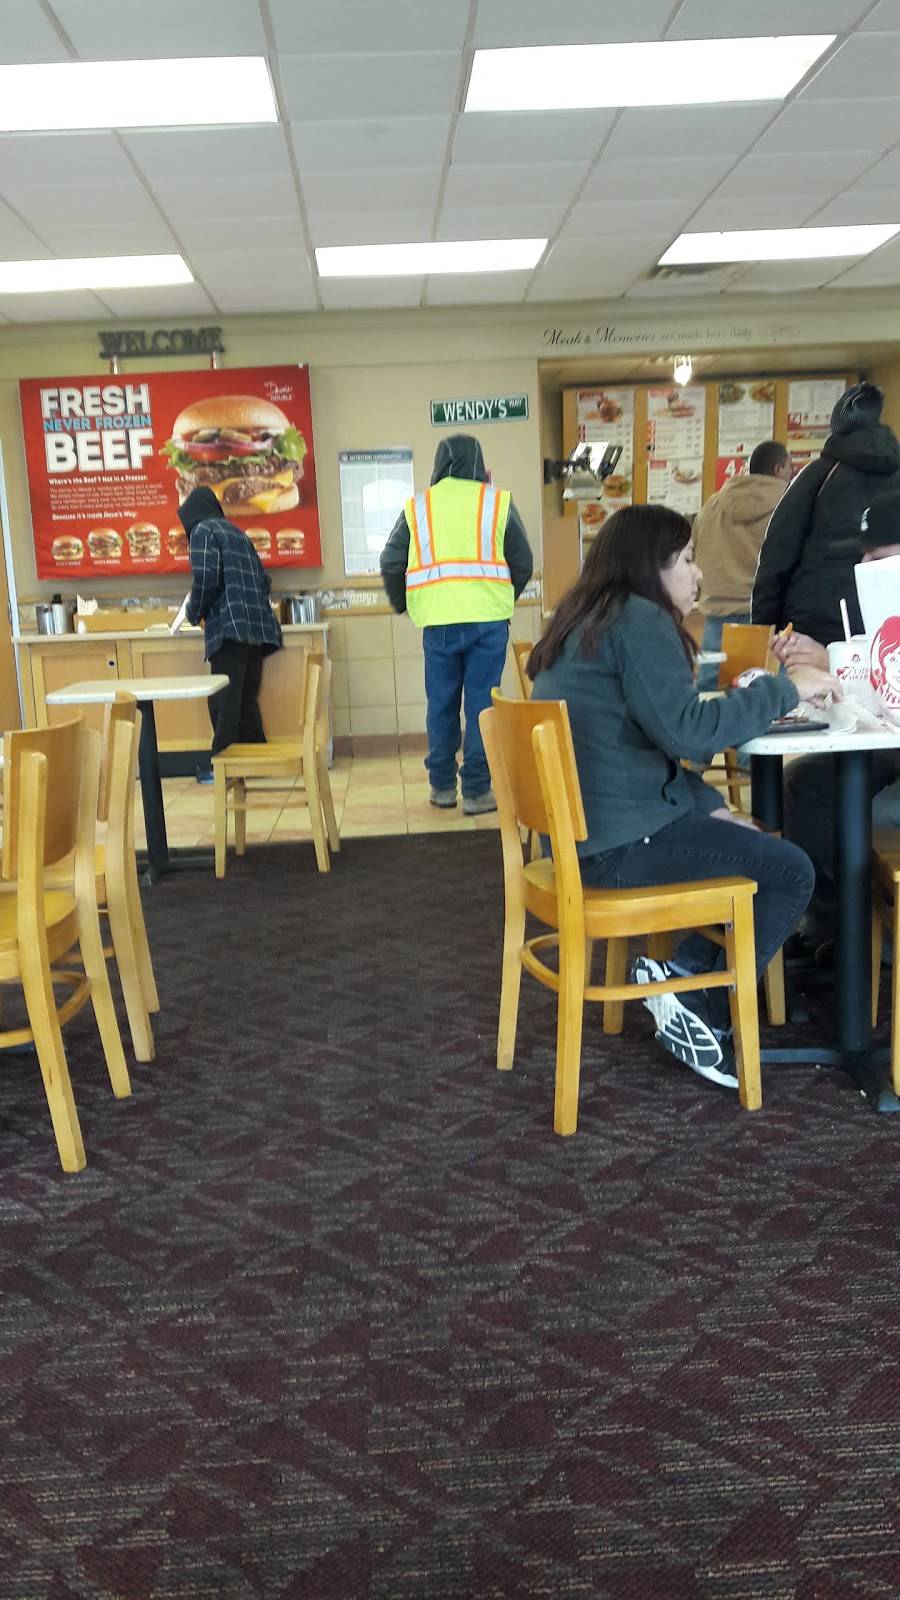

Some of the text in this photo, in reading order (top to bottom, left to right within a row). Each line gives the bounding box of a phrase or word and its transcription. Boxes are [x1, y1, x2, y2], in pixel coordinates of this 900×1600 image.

[99, 327, 224, 358] WELCOME
[730, 327, 752, 340] daily
[40, 383, 150, 419] FRESH
[443, 398, 507, 422] WENDY'S
[44, 414, 151, 432] NEVER FROZEN
[45, 428, 153, 473] BEEF
